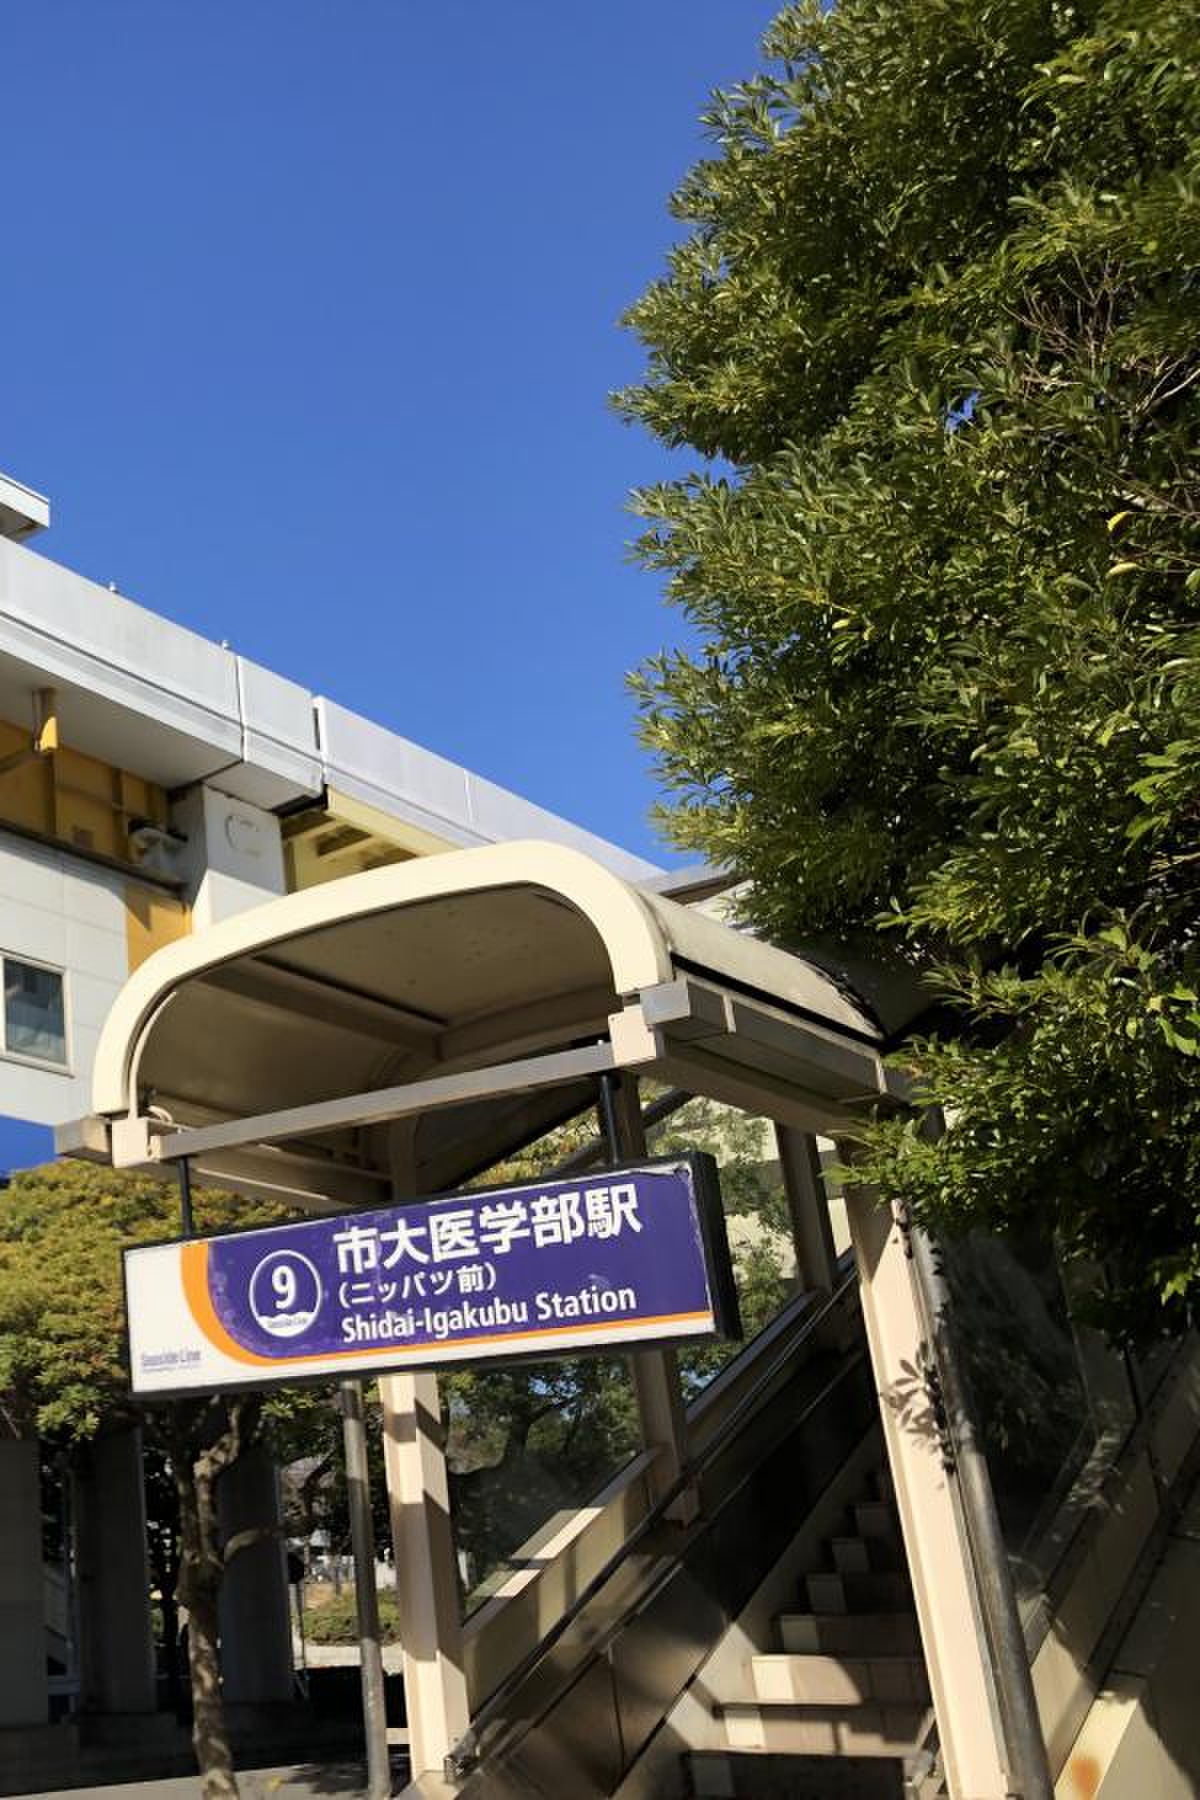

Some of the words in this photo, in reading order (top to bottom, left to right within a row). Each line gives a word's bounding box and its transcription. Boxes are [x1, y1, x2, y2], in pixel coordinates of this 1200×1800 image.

[333, 1183, 643, 1274] 市大医学部駅
[272, 1265, 296, 1309] 9
[342, 1296, 528, 1343] Shidai-Igakubu
[535, 1285, 637, 1320] Station
